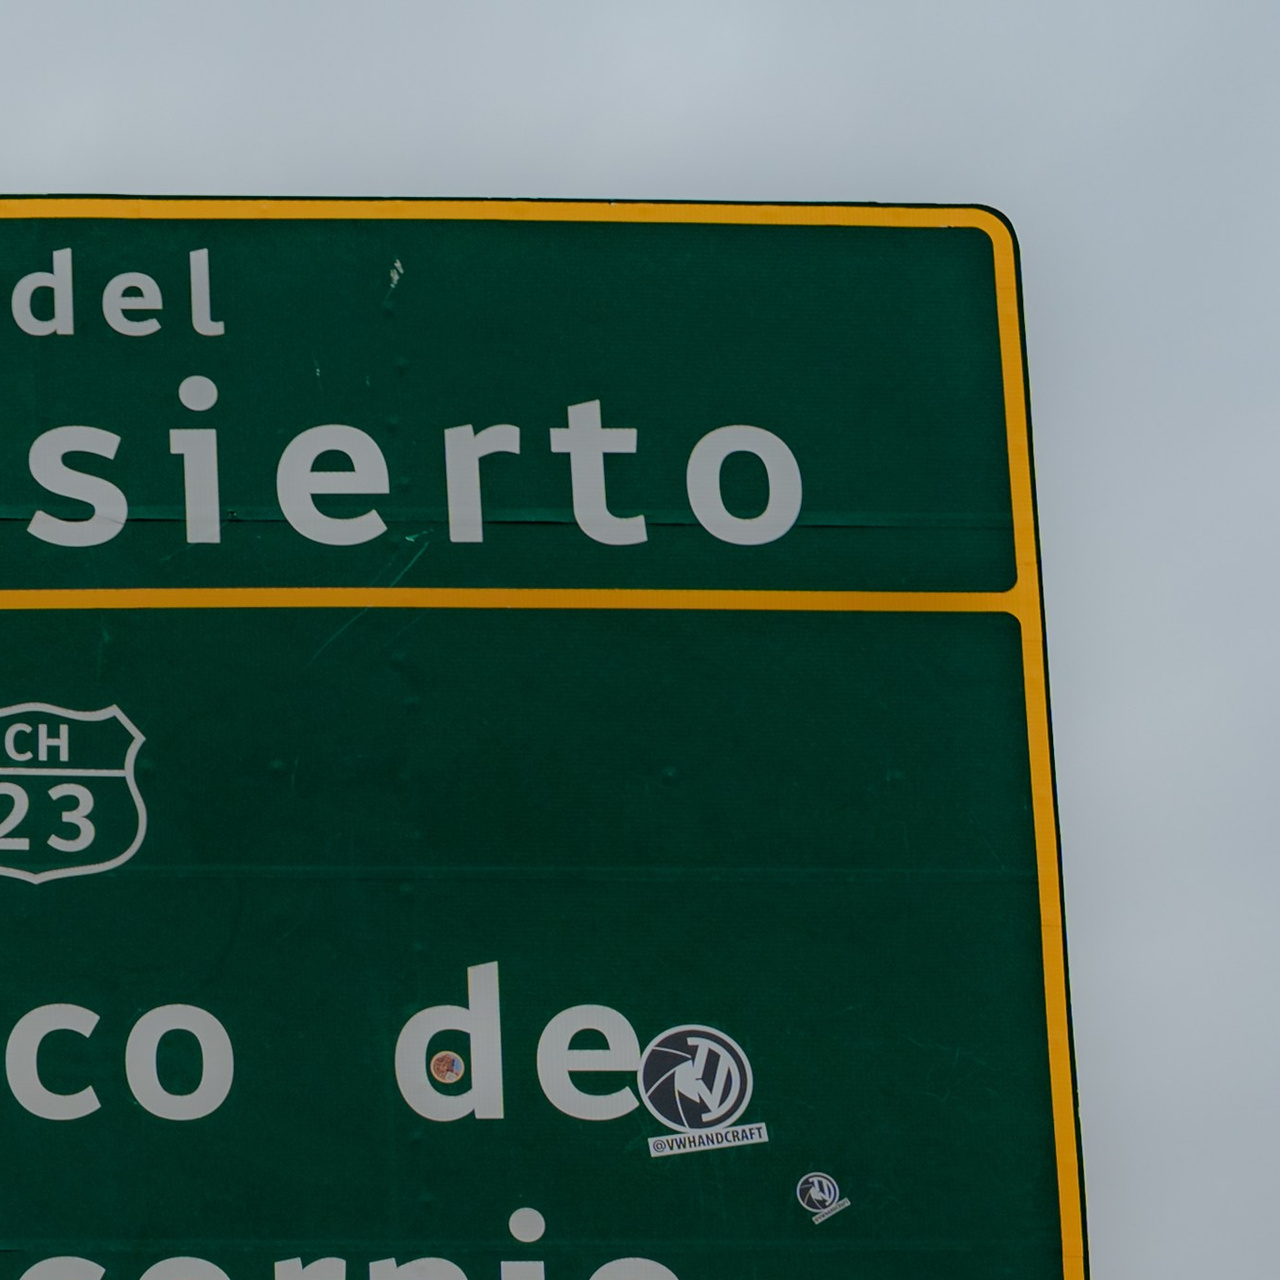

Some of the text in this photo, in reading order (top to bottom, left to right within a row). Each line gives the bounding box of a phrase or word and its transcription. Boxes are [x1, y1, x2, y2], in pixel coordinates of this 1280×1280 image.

[5, 723, 68, 761] CH
[395, 962, 639, 1121] de
[652, 1127, 764, 1153] @VWHANDCRAFT
